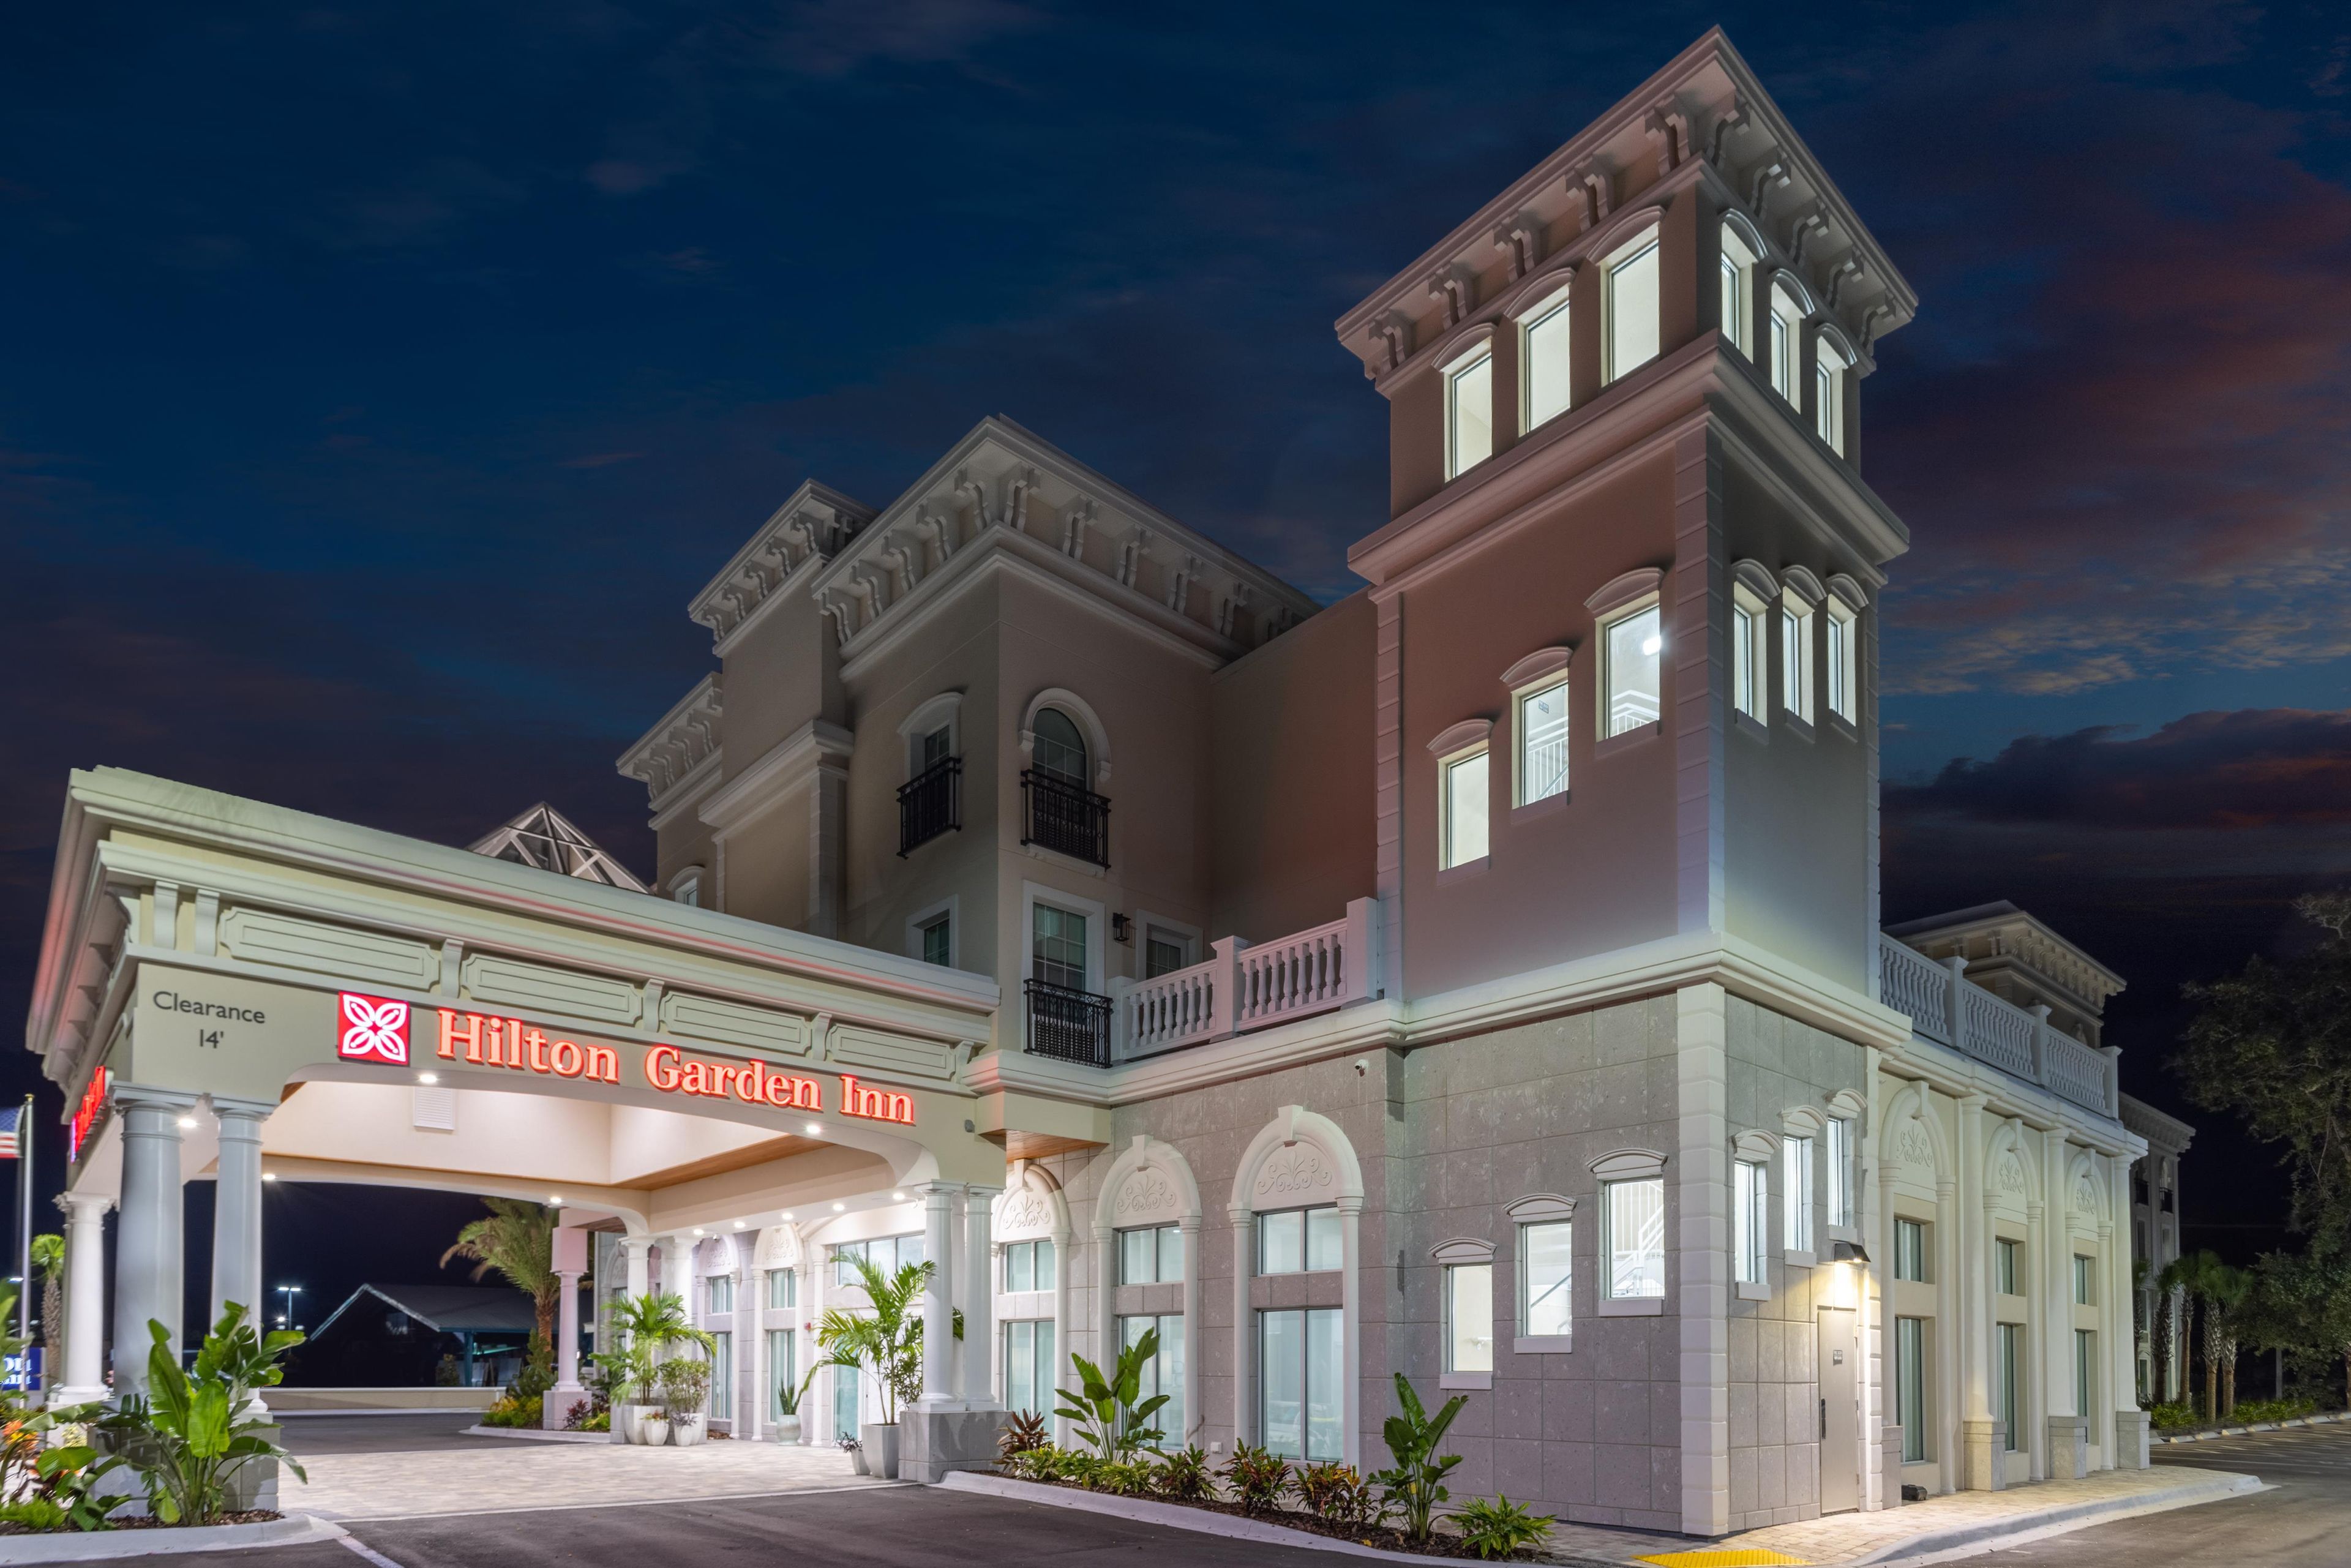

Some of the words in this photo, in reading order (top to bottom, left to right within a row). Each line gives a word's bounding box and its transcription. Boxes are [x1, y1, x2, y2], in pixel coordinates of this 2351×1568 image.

[152, 991, 265, 1024] Clearance
[199, 1029, 224, 1049] 14'
[437, 1008, 619, 1083] Hilton
[644, 1045, 823, 1111] Garden
[839, 1075, 915, 1124] Inn
